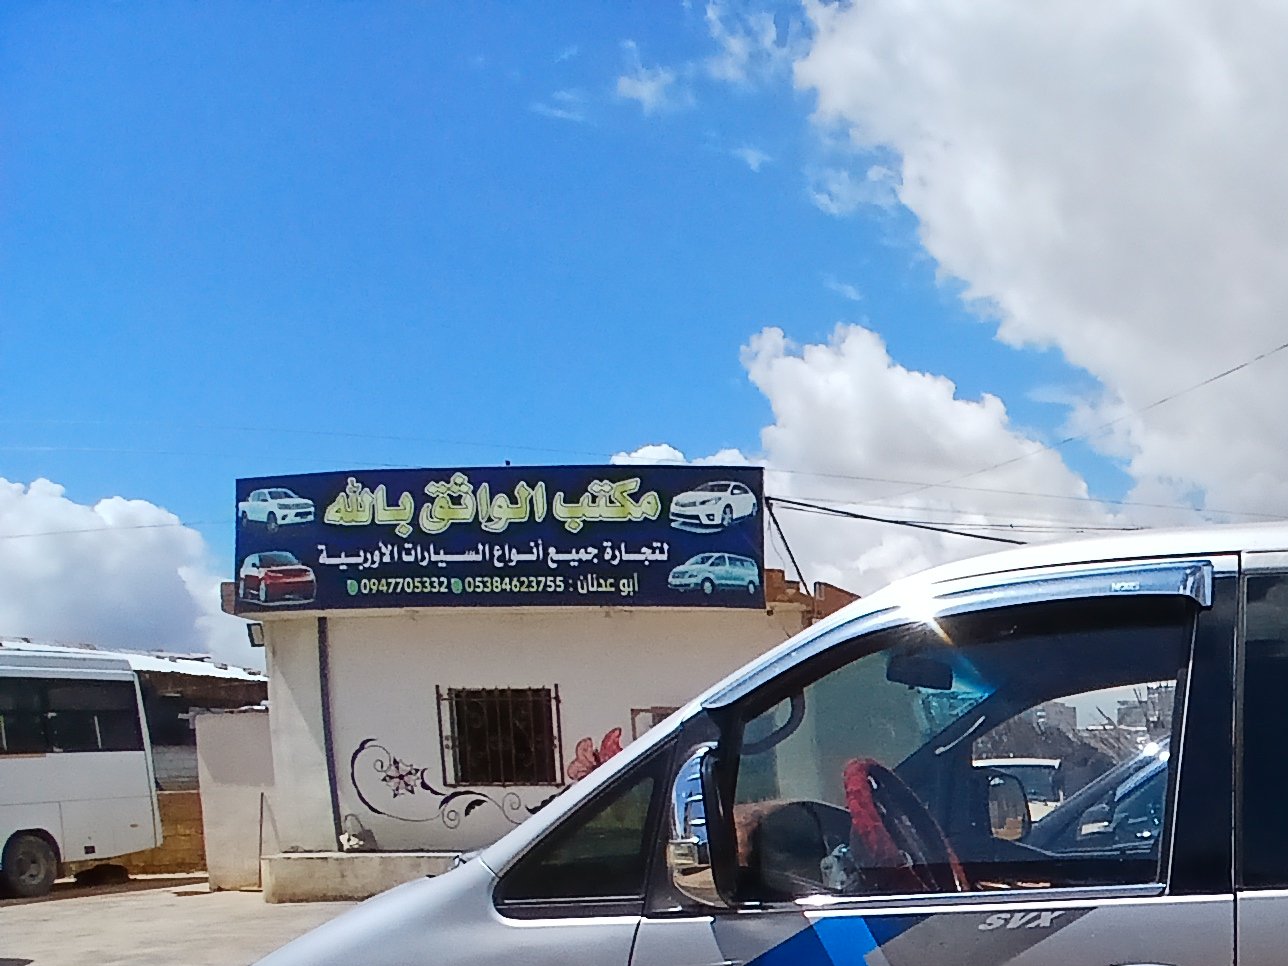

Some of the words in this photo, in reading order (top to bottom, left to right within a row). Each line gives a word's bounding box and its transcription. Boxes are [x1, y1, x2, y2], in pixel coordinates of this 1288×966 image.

[324, 477, 414, 538] بالله
[419, 472, 547, 534] الواثق
[553, 477, 661, 533] مكتب
[401, 542, 490, 568] السيارات
[493, 538, 544, 568] أنواع
[547, 546, 599, 569] جميع
[602, 541, 669, 566] لتجارة
[360, 577, 449, 594] 0947705332
[464, 576, 565, 593] 05384623755
[577, 573, 616, 594] عدنان
[978, 910, 1066, 930] SVX
